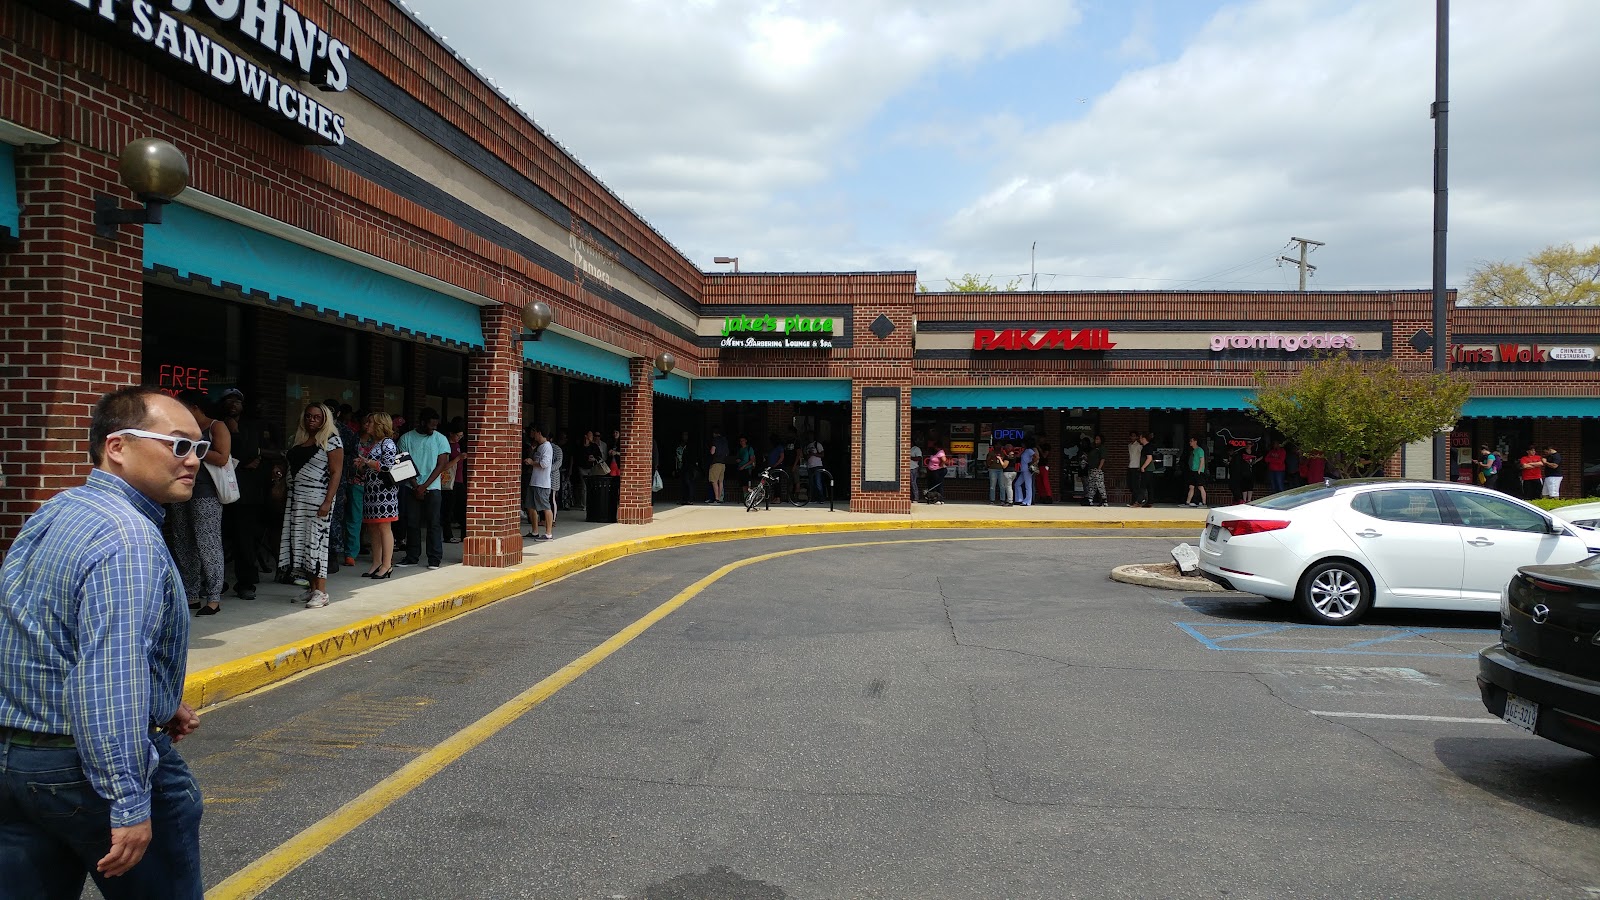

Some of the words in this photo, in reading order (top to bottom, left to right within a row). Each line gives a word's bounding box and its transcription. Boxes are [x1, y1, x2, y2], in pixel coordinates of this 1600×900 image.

[171, 0, 349, 92] HN'S
[133, 0, 345, 146] SANDWICHES
[721, 314, 777, 337] jake's
[784, 314, 833, 336] place
[1499, 343, 1546, 363] Wok
[160, 364, 209, 390] FREE
[952, 425, 972, 433] FedEx
[994, 429, 1024, 440] OPEN
